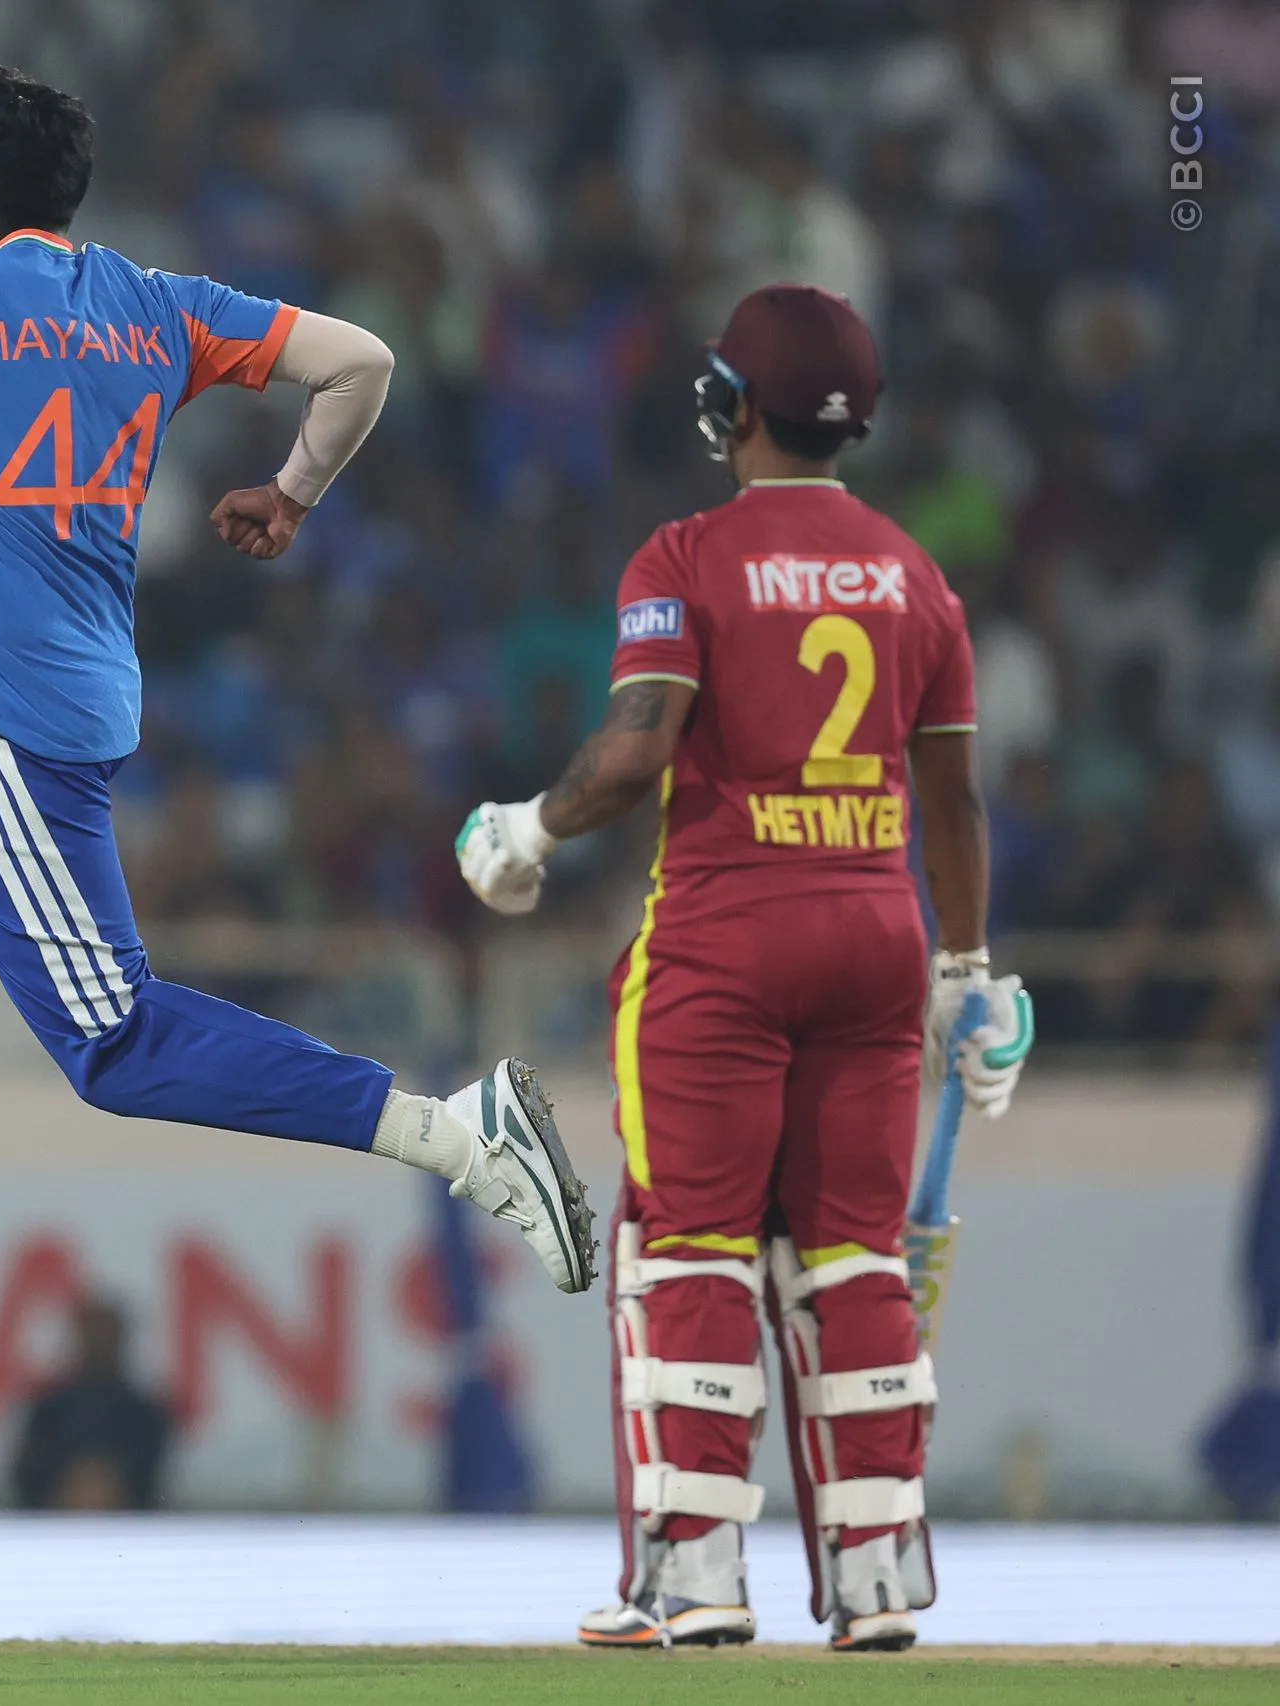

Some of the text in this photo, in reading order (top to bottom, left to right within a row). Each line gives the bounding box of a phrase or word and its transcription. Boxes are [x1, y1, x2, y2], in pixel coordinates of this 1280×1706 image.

[797, 613, 883, 788] 2
[694, 1378, 733, 1400] TON
[868, 1376, 907, 1396] TON
